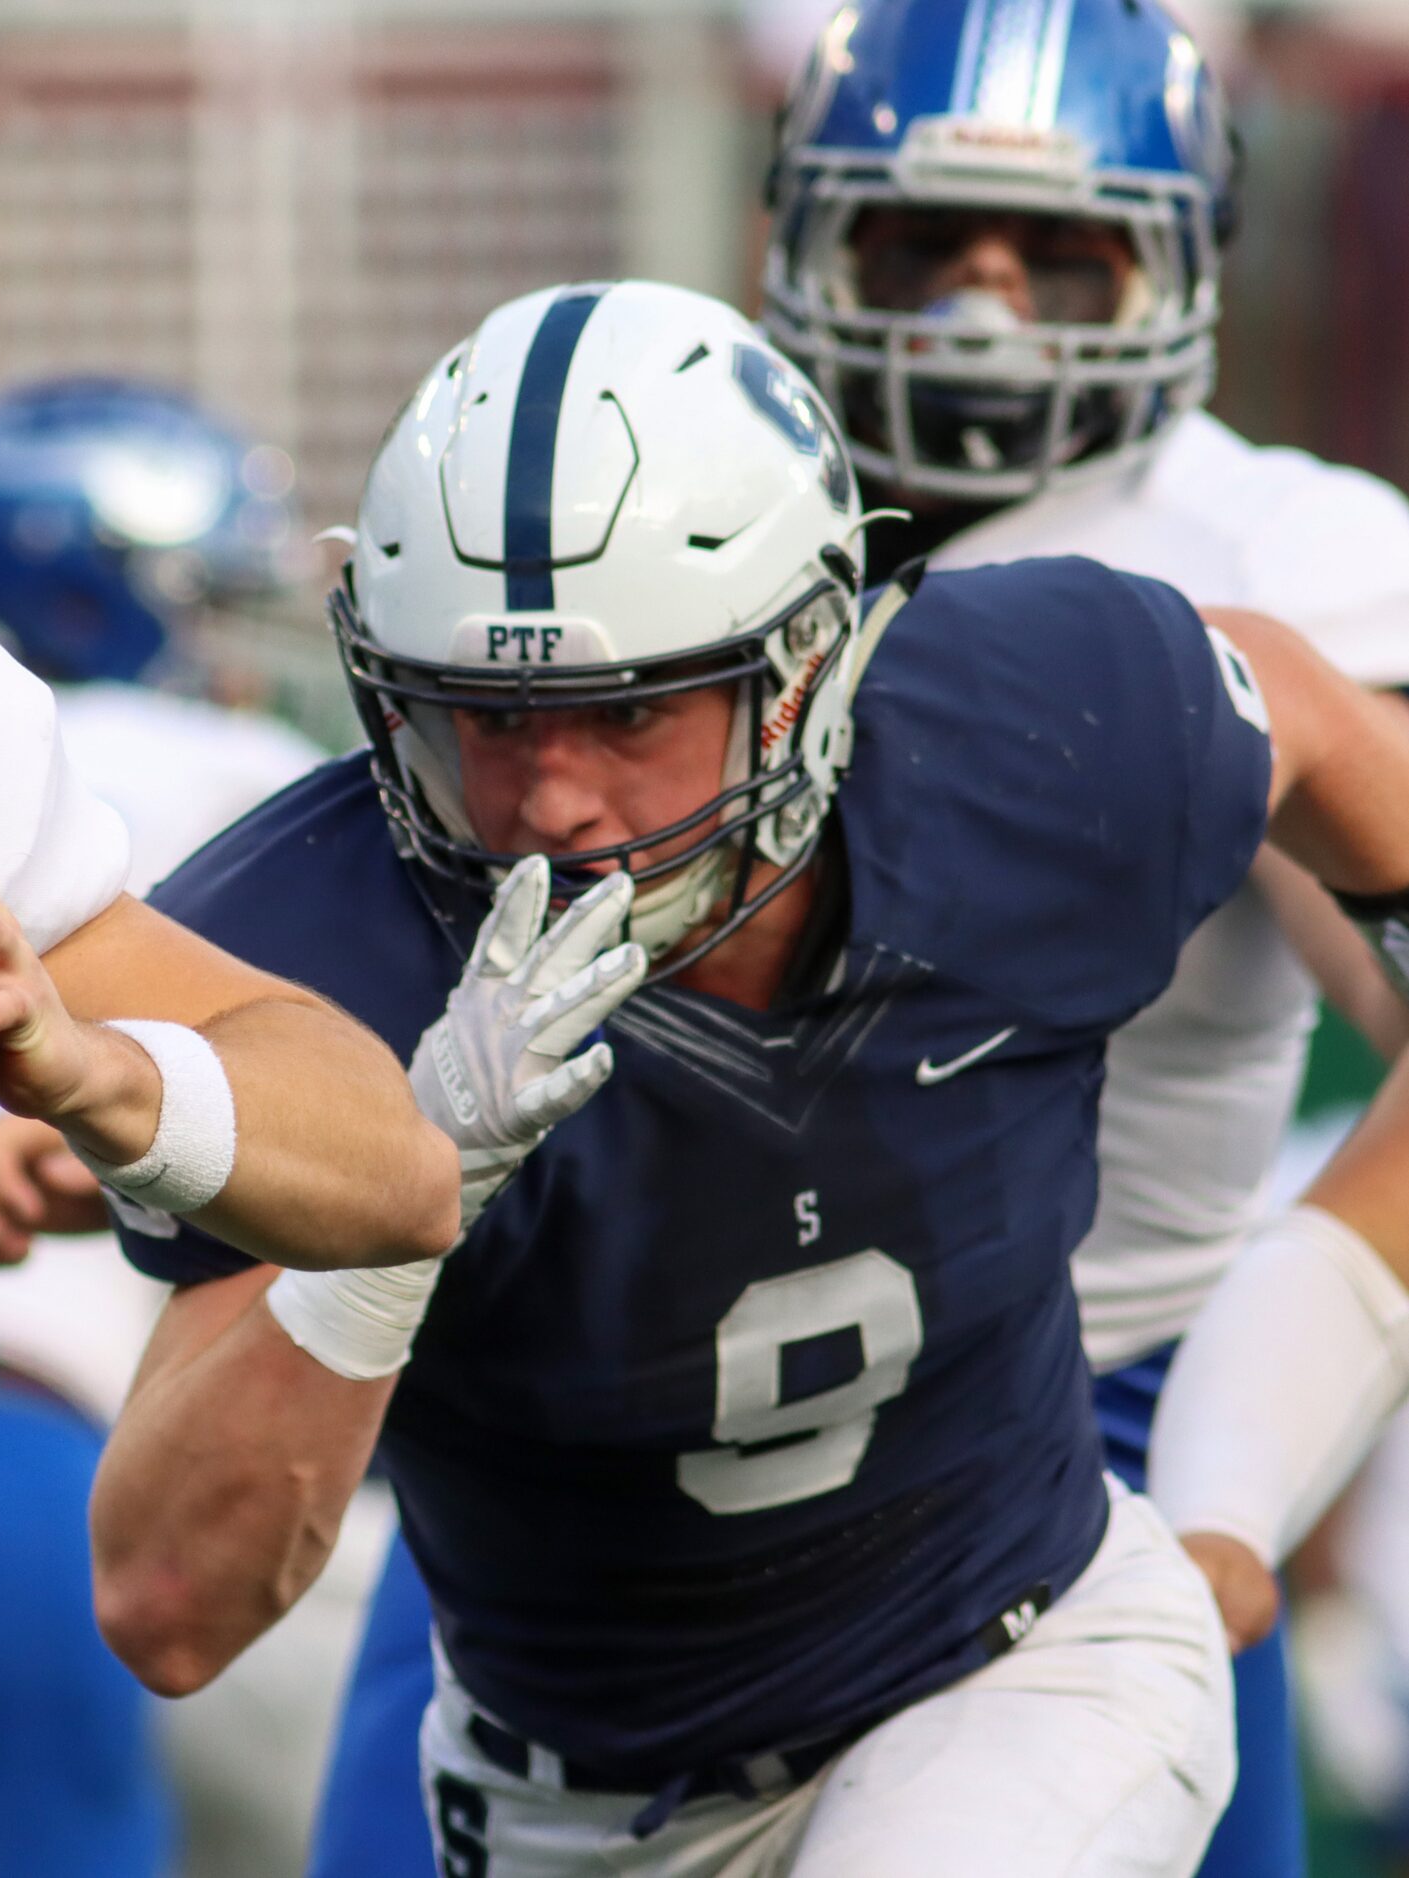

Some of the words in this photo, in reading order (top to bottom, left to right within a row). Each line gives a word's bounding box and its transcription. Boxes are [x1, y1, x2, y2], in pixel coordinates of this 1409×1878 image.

[487, 625, 562, 662] PTF
[793, 1189, 822, 1246] S
[676, 1247, 923, 1515] 9
